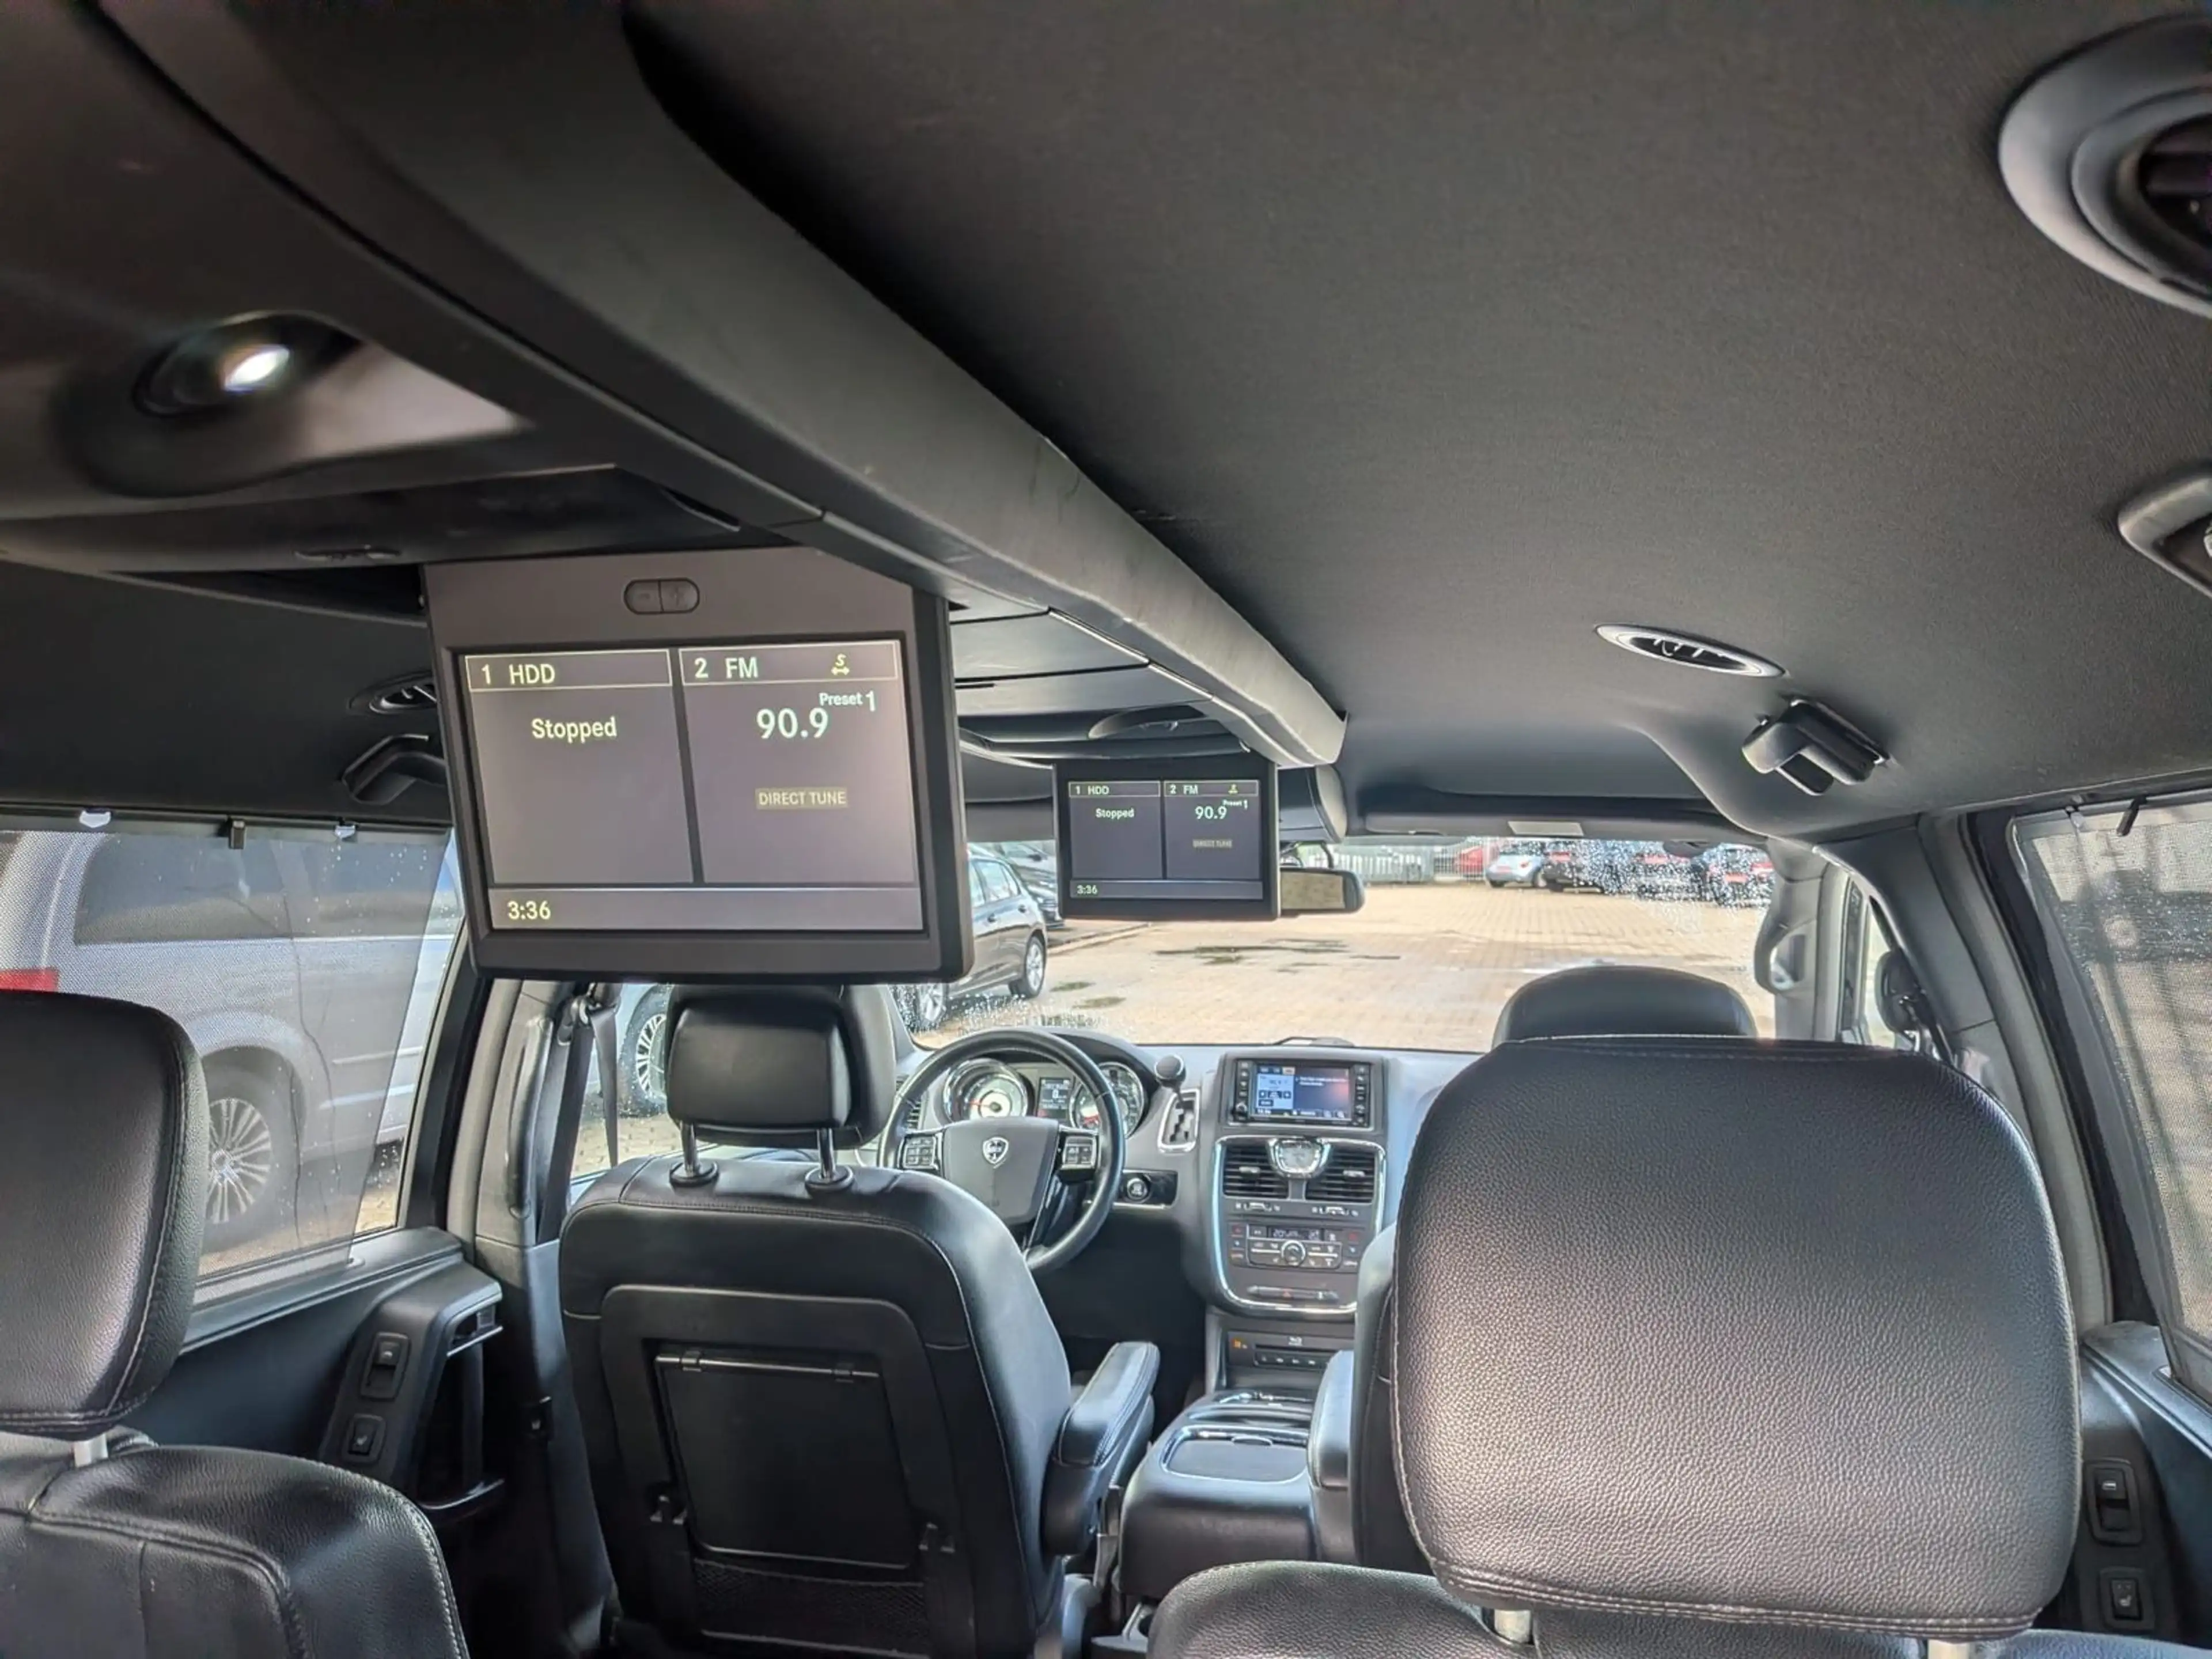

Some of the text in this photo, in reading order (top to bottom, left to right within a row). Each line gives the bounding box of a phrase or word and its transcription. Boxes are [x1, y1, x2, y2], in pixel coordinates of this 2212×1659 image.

[481, 664, 555, 685] 1 HDD
[694, 657, 759, 679] 2 FM
[819, 690, 876, 712] Preset 1
[531, 715, 617, 744] Stopped
[756, 707, 828, 738] 90.9
[758, 791, 846, 805] DIRECT TUNE
[1075, 785, 1081, 795] 1
[1169, 784, 1198, 794] 2 FM
[1096, 807, 1134, 820] Stopped
[1195, 806, 1227, 819] 90.9
[507, 900, 551, 920] 3:36
